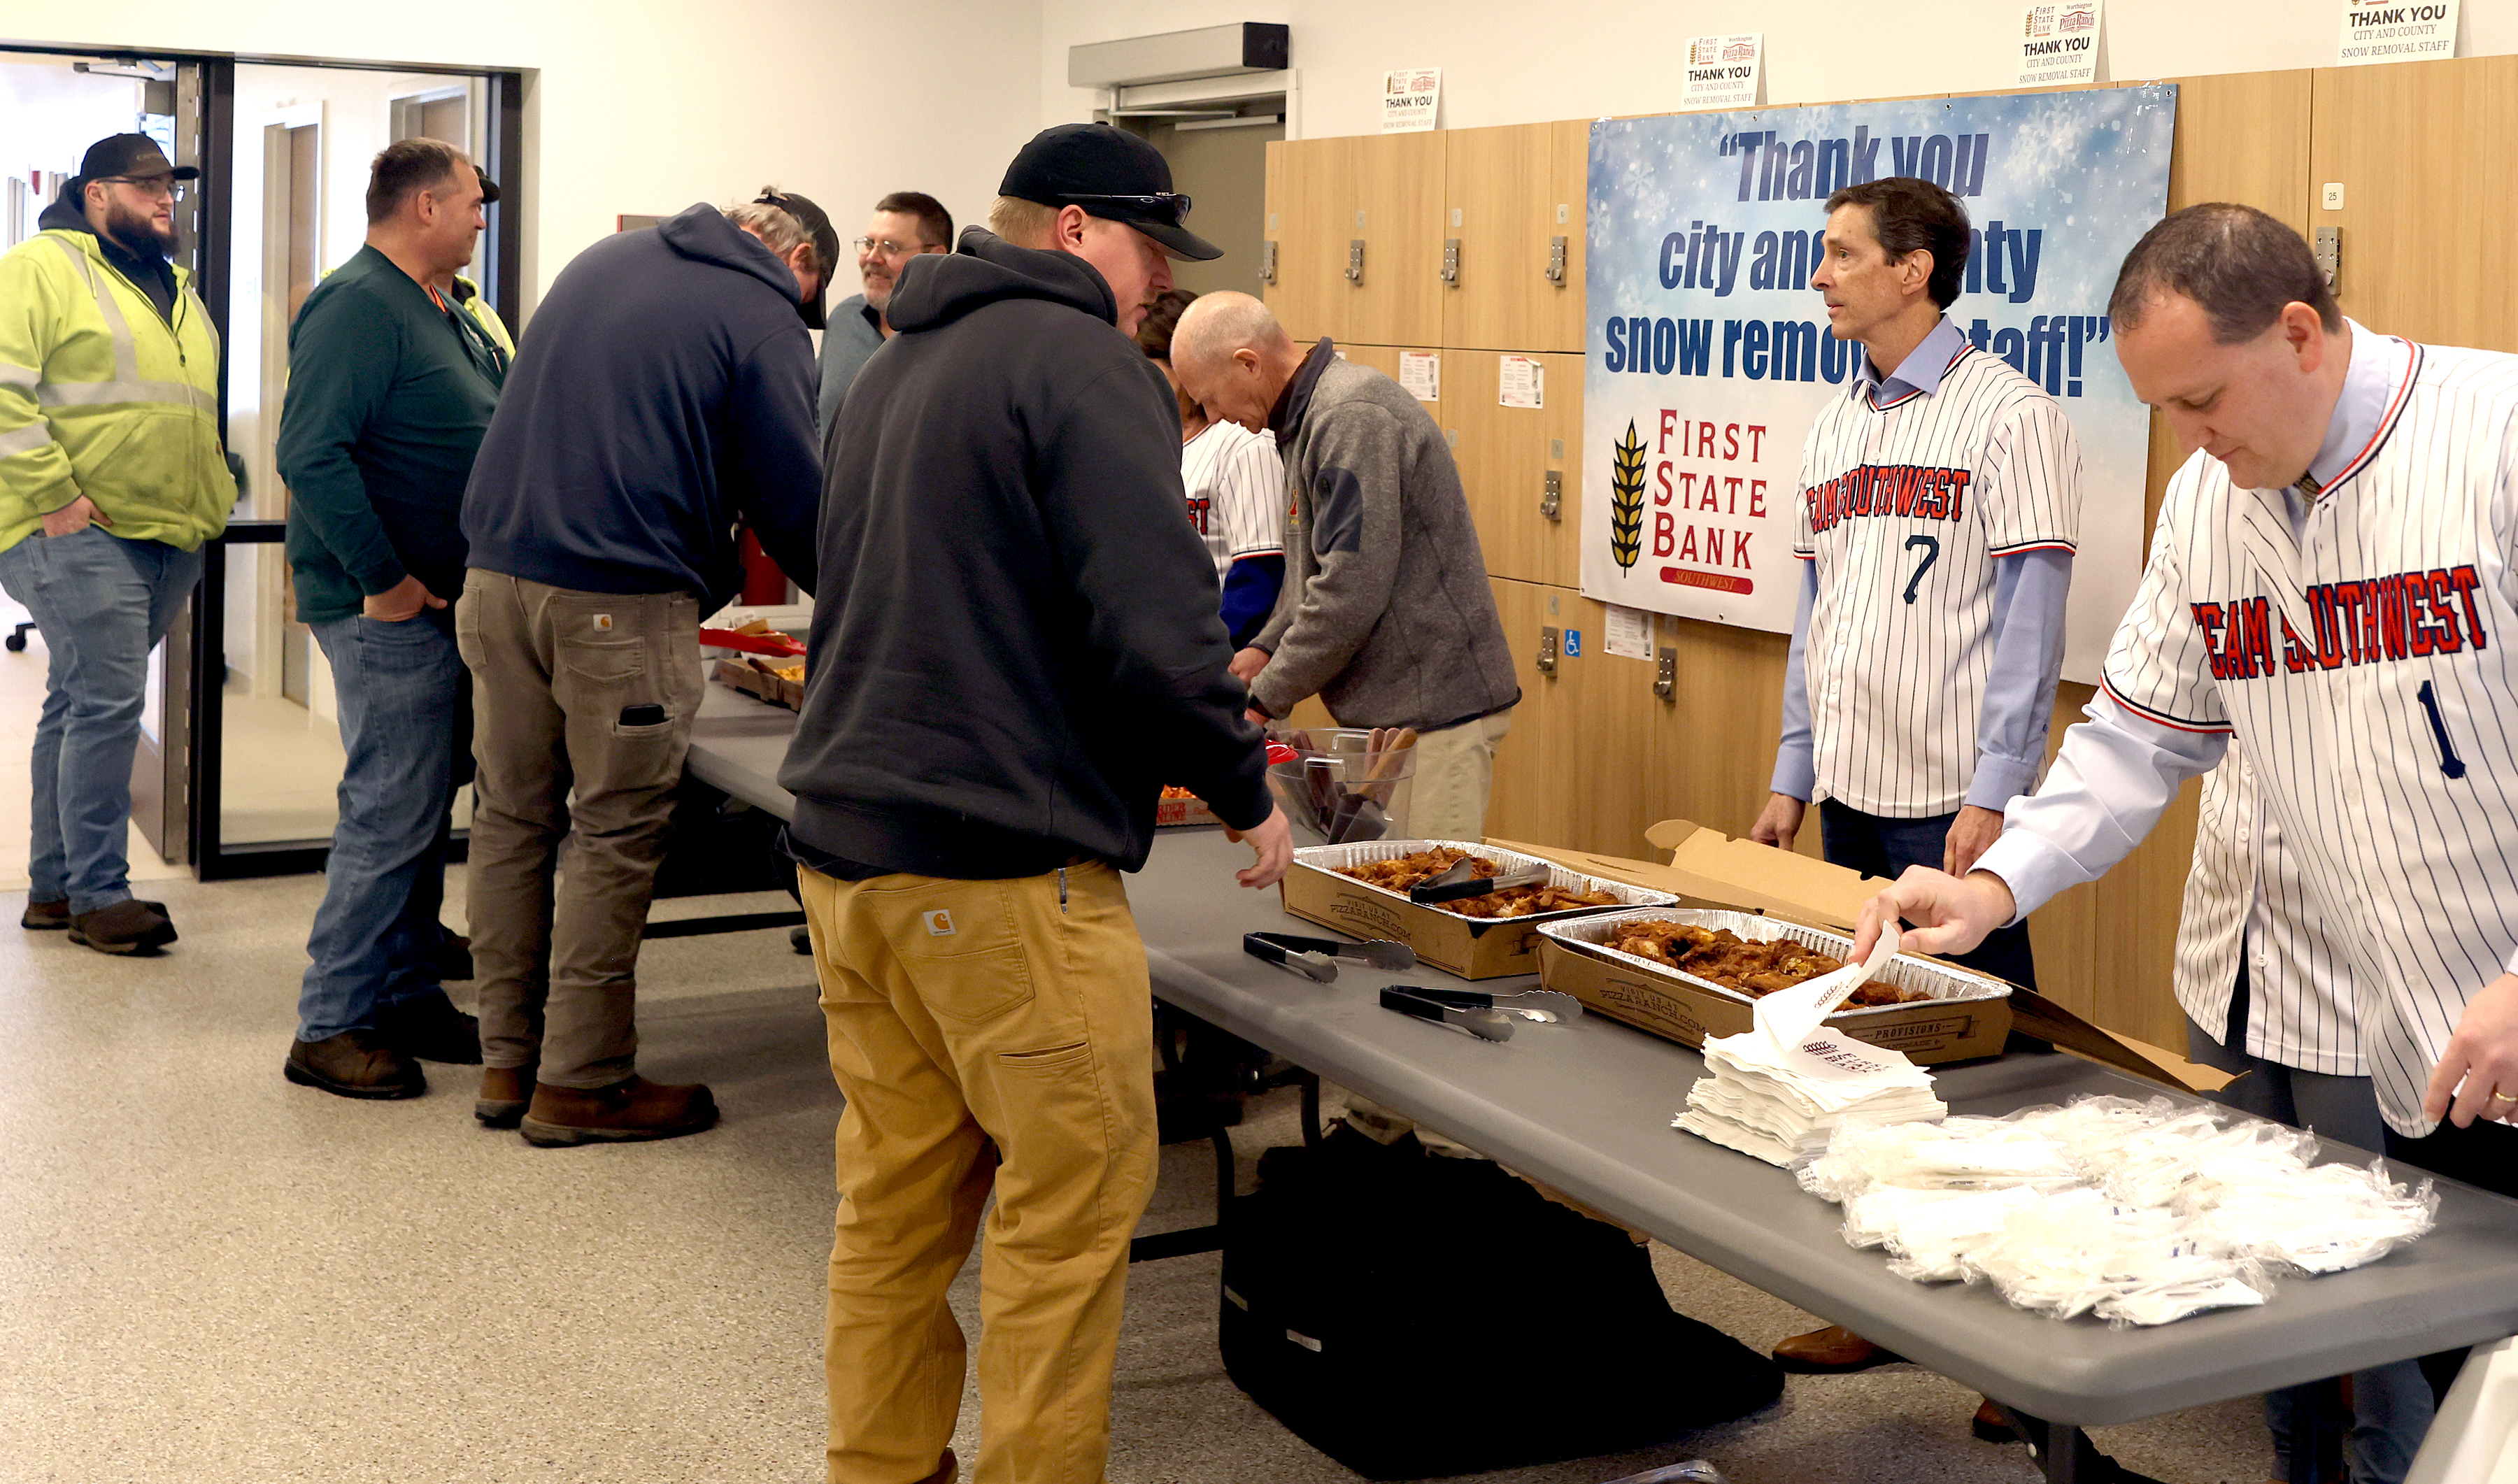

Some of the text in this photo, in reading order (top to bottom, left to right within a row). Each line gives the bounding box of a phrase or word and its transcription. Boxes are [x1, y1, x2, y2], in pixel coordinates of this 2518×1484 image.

[2035, 6, 2055, 15] FIRST
[2349, 4, 2446, 27] THANK YOU
[2033, 15, 2054, 24] STATE
[2059, 13, 2094, 30] Pizza Ranch
[2033, 24, 2051, 33] BANK
[2354, 24, 2437, 41] CITY AND COUNTY
[1722, 45, 1755, 59] Pizza Ranch
[2024, 36, 2090, 57] THANK YOU
[2342, 40, 2449, 58] SNOW REMOVAL STAFF
[2026, 54, 2083, 69] CITY AND COUNTY
[1688, 66, 1751, 81] THANK YOU
[2019, 68, 2091, 84] SNOW REMOVAL STAFF
[1705, 83, 1719, 91] AND
[1720, 81, 1745, 90] COUNTY
[1386, 96, 1432, 108] THANK YOU
[1684, 93, 1753, 105] SNOW REMOVAL STAFF
[2328, 192, 2337, 201] 25
[1659, 220, 1745, 296] city
[1749, 229, 1826, 291] an
[1605, 315, 1713, 376] snow
[1722, 319, 1865, 385] remo
[1658, 408, 1766, 463] FIRST
[1654, 460, 1767, 519] STATE
[1806, 478, 1840, 535] EAM
[1652, 511, 1754, 570] BANK
[1903, 535, 1940, 604] 7
[1675, 567, 1737, 591] SOUTHWEST
[2191, 596, 2276, 680] EAM
[2417, 680, 2466, 779] 1
[1158, 802, 1186, 812] RDER
[1158, 811, 1186, 823] NLINE
[1347, 899, 1365, 908] VISIT
[1369, 906, 1378, 914] US
[1330, 904, 1411, 941] PIZZARANCH.COM
[1621, 986, 1677, 1010] VISIT US AT
[1600, 990, 1707, 1034] PIZZARANCH.COM
[1875, 1023, 1941, 1039] PROVISIONS
